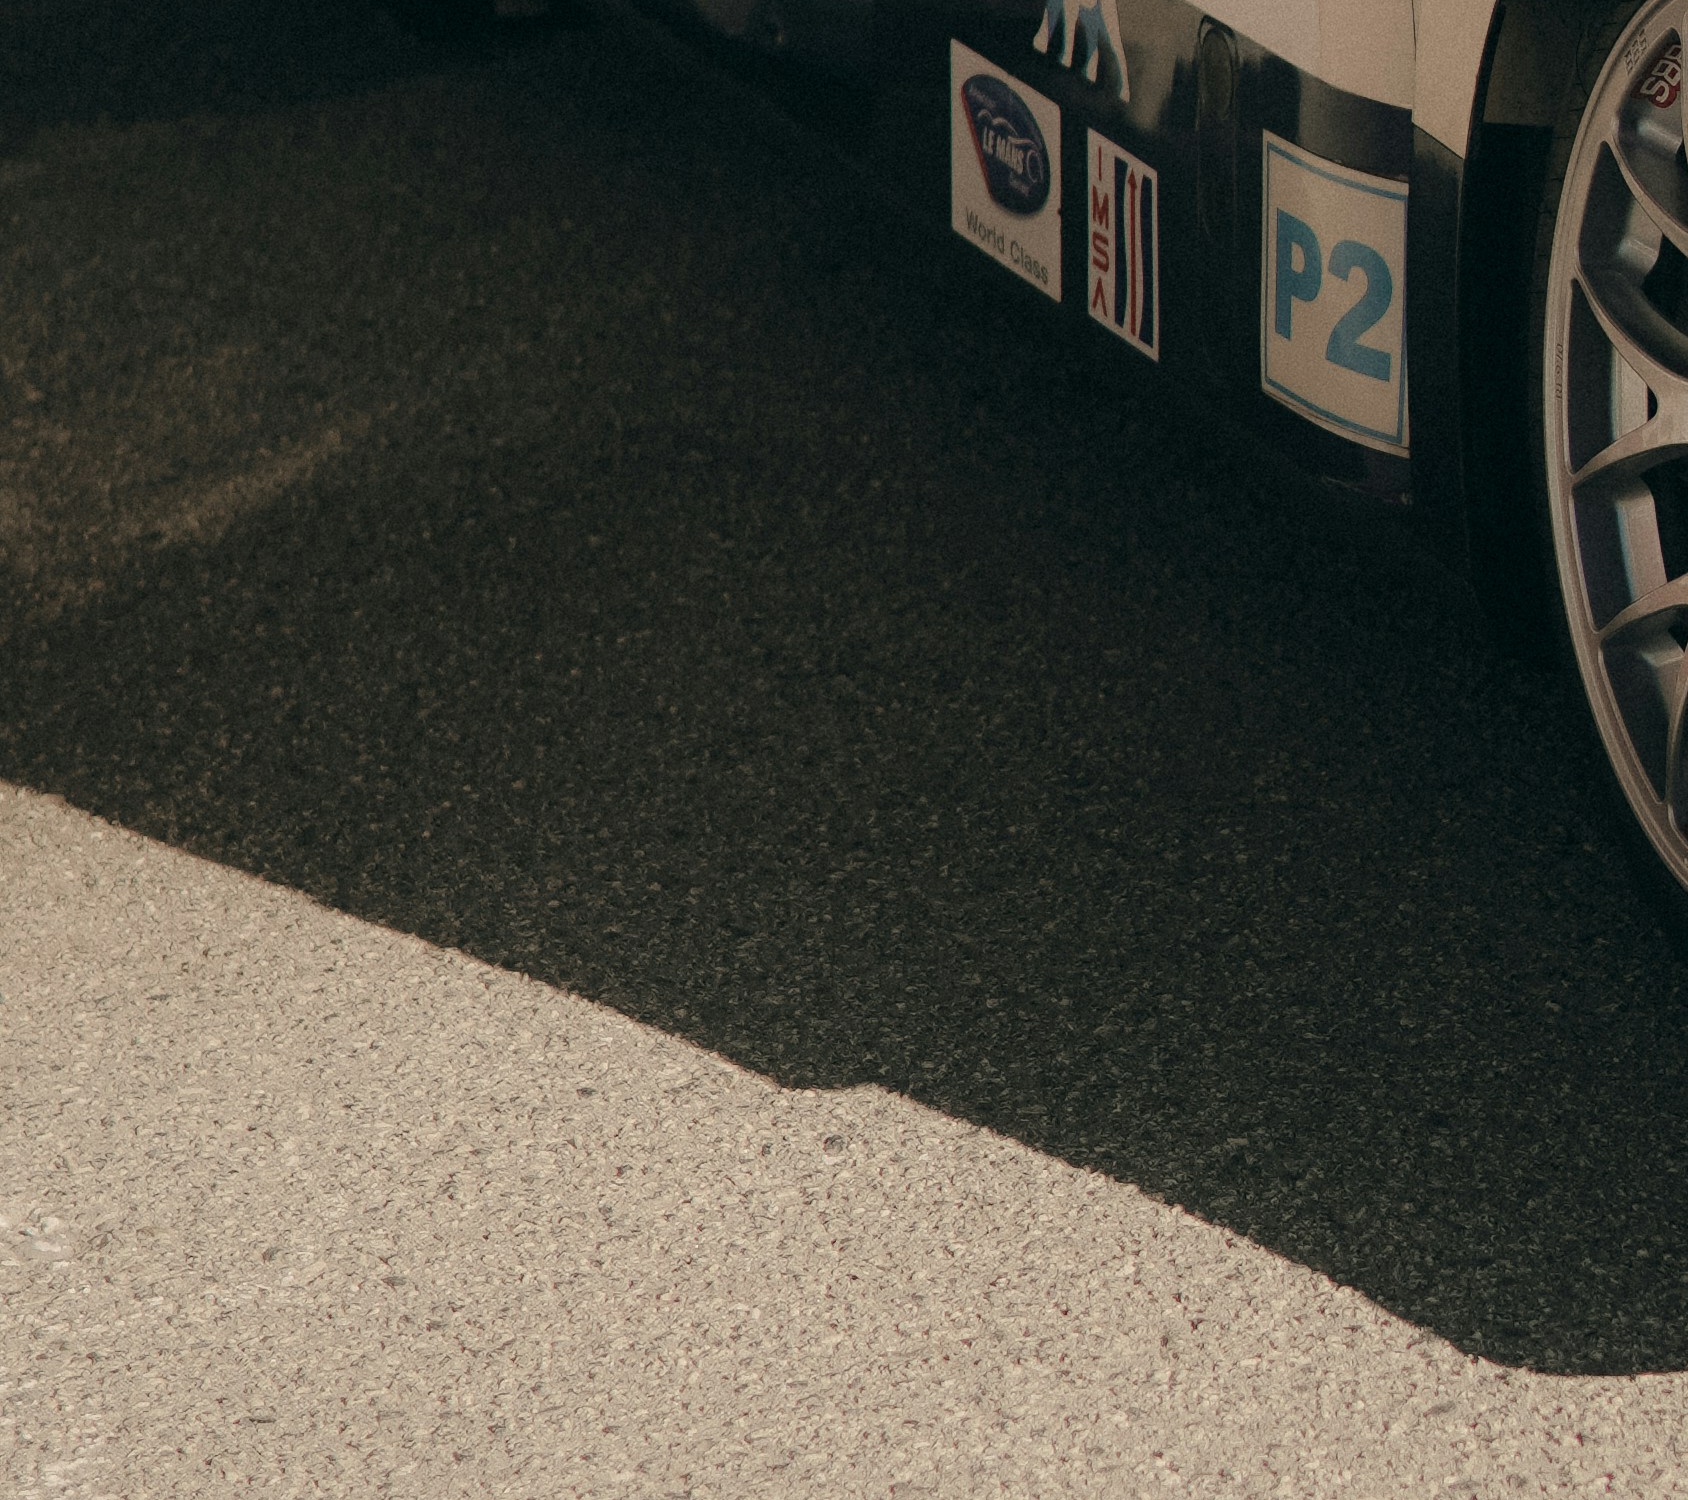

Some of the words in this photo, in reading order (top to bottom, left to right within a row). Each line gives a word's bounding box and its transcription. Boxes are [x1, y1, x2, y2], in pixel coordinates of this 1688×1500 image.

[964, 204, 1006, 255] World
[1008, 238, 1050, 287] Class
[1273, 206, 1396, 384] P2
